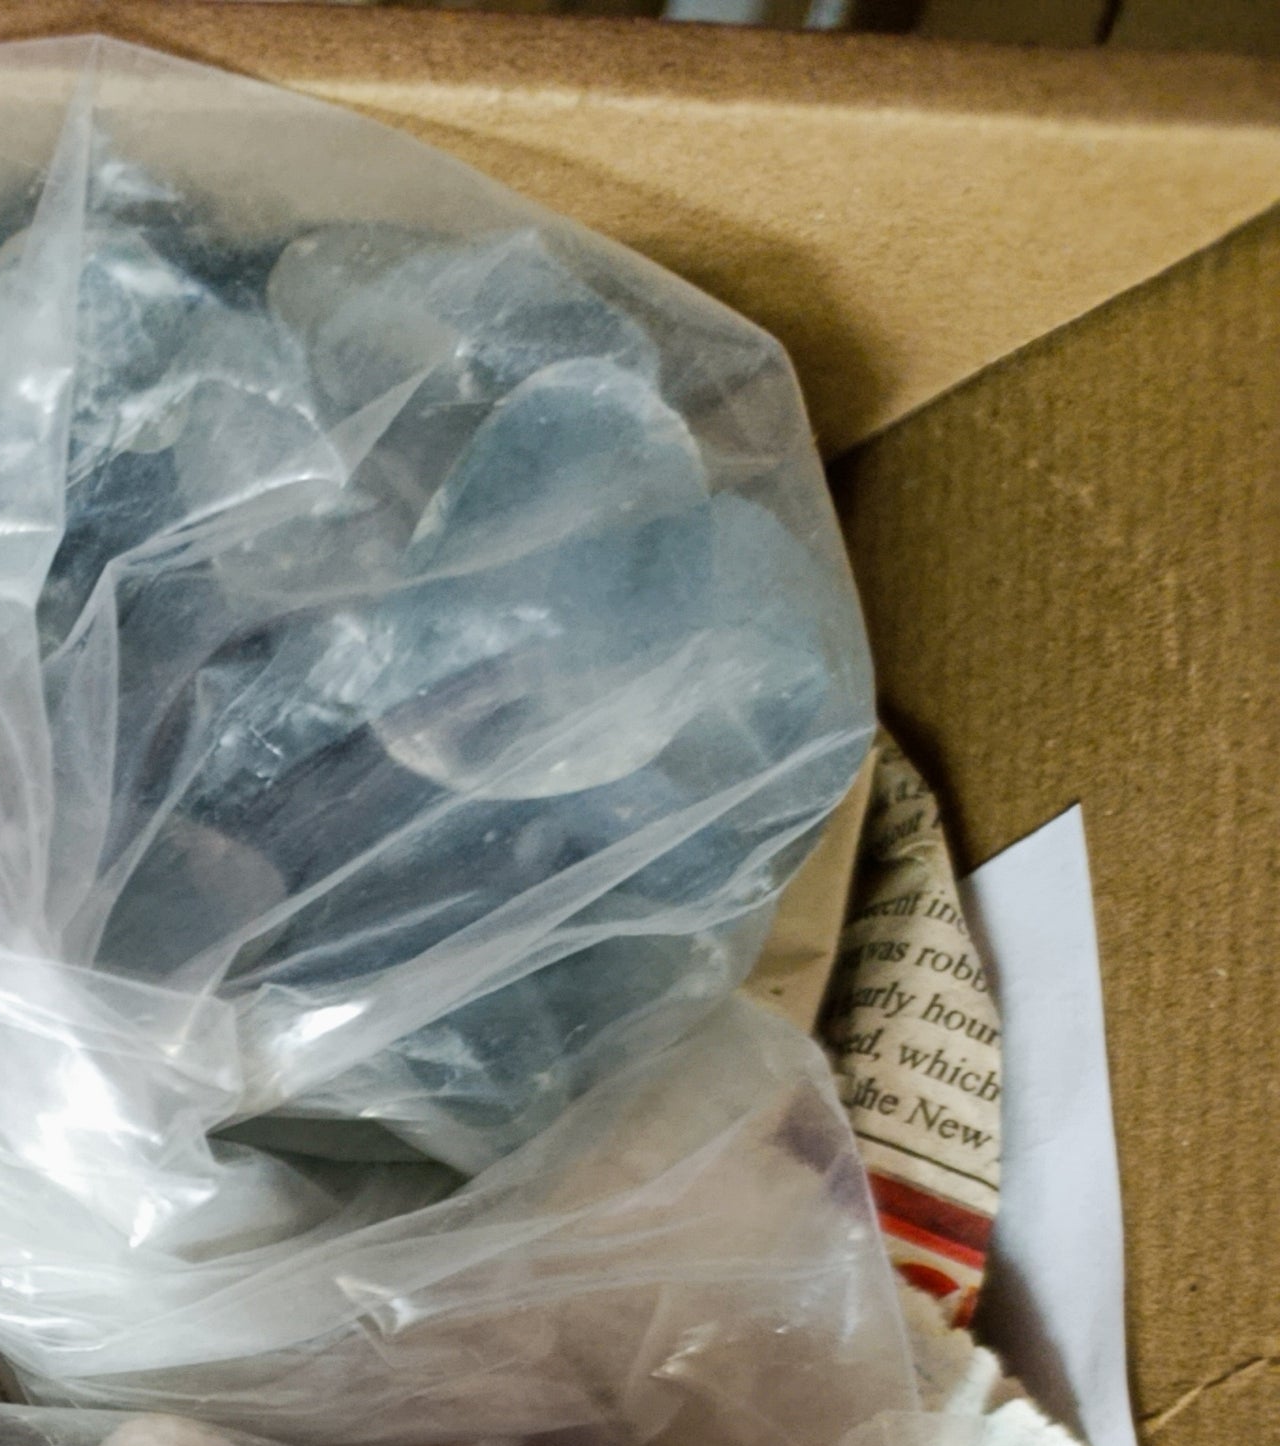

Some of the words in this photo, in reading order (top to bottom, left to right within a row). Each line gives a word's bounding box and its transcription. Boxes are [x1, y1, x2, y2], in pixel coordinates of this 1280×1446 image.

[920, 945, 986, 996] robb
[852, 980, 916, 1018] arly
[920, 994, 1001, 1048] hour
[898, 1037, 1001, 1102] which
[905, 1093, 997, 1152] New
